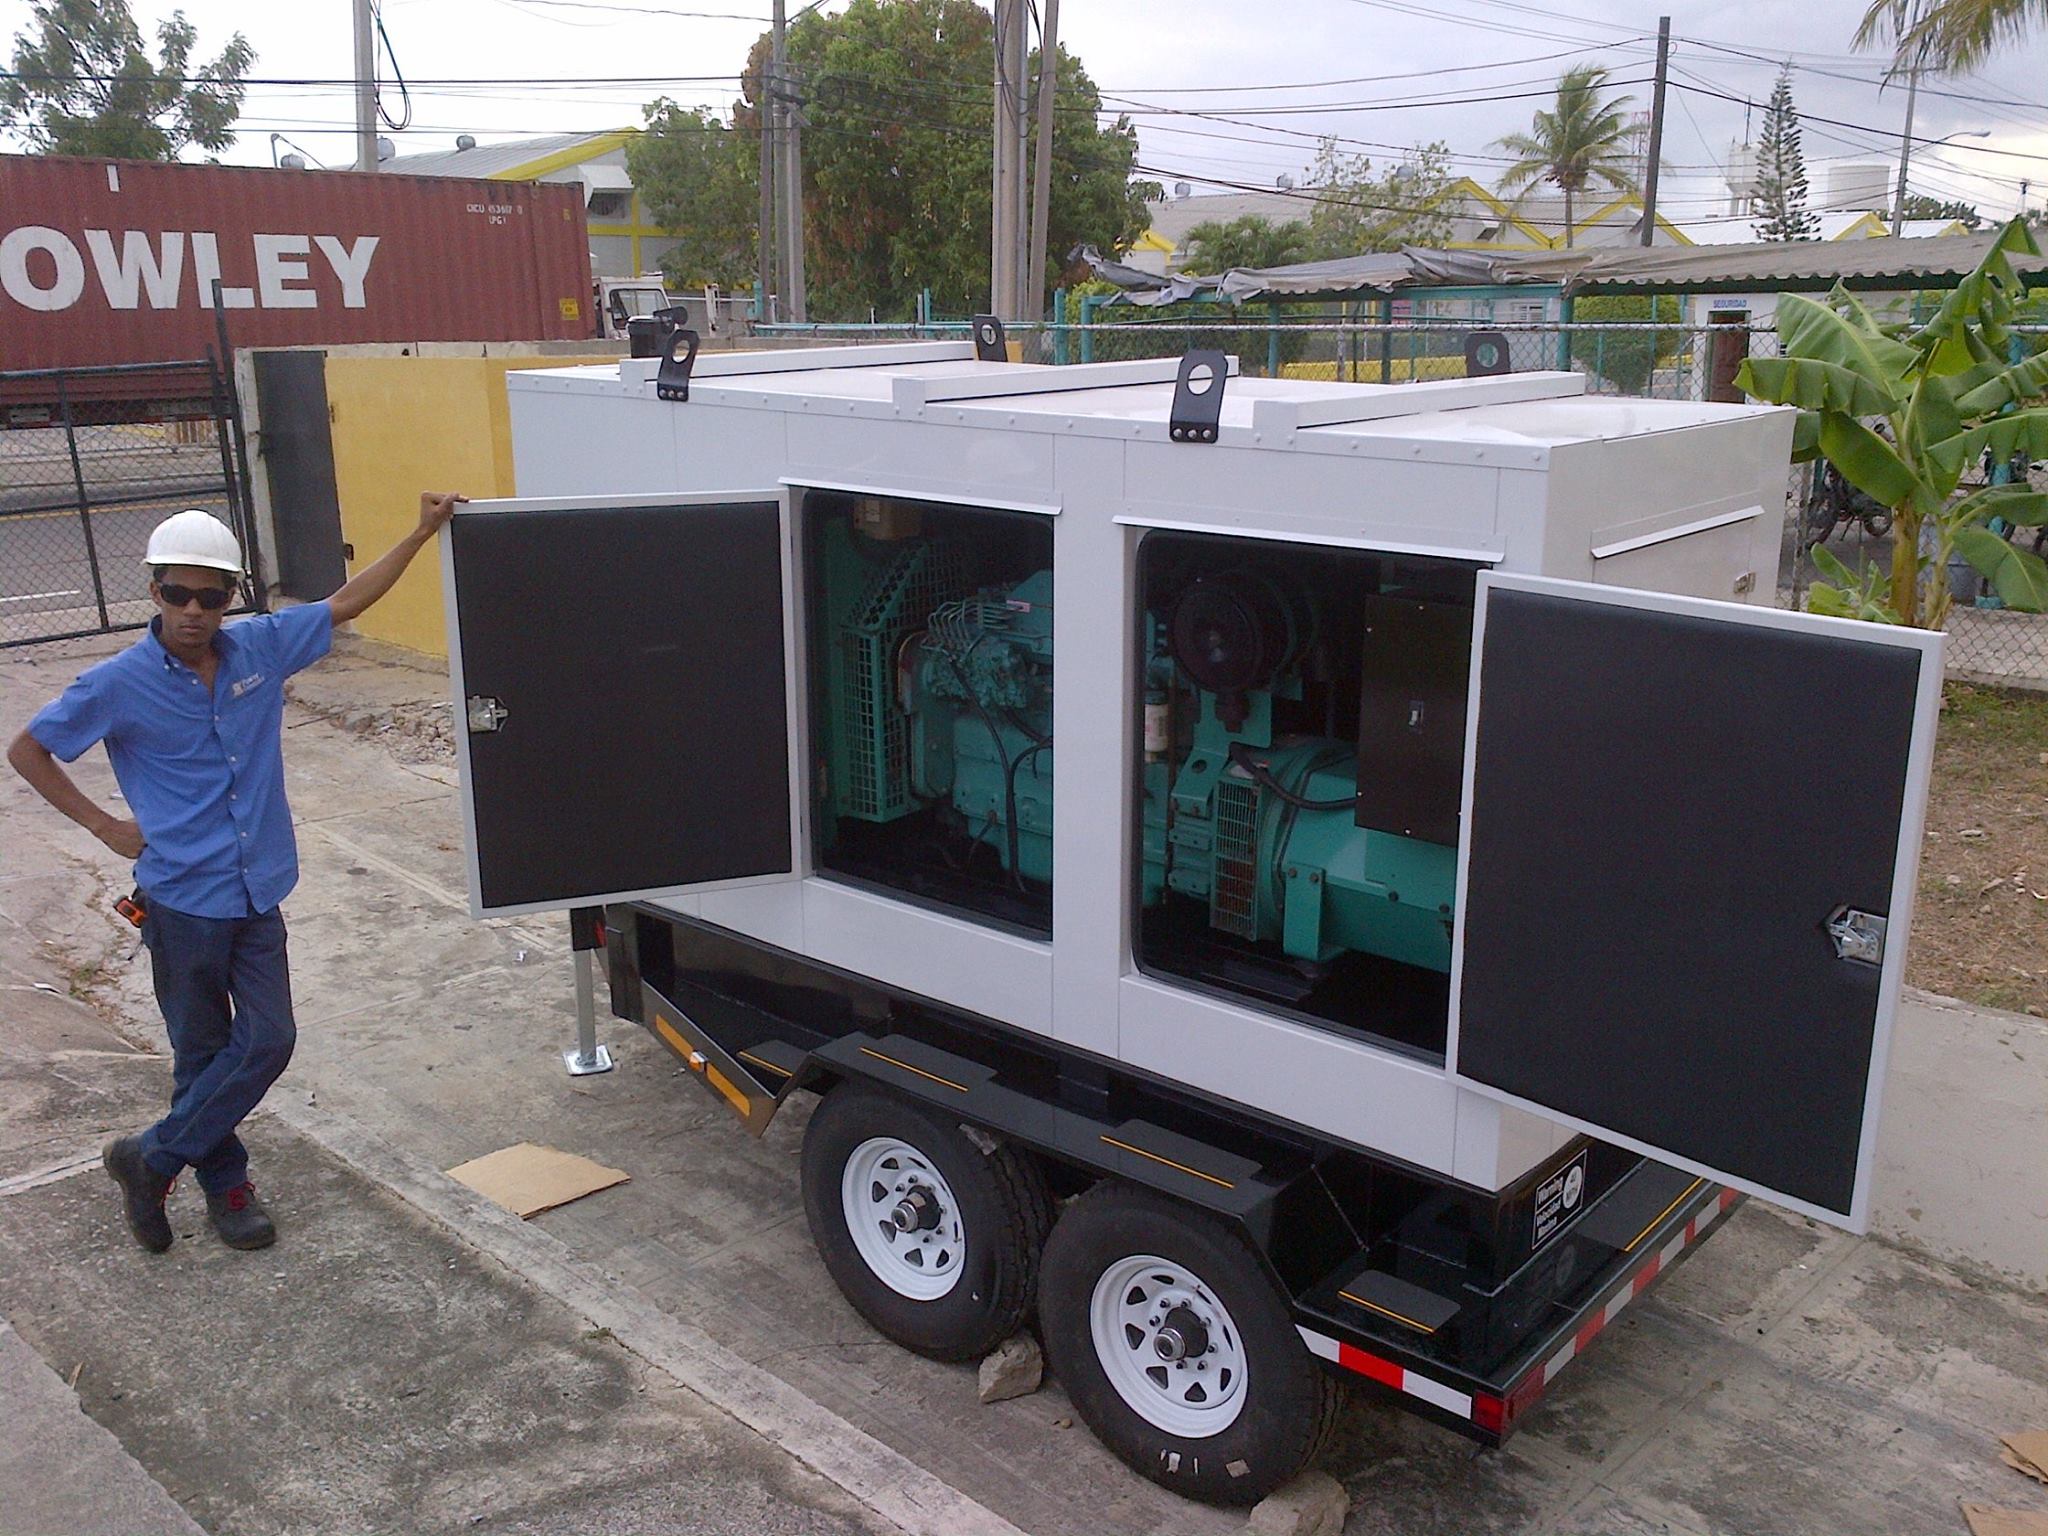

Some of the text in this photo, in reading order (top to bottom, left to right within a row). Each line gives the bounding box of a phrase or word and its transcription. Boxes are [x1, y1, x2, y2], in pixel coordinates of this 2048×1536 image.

[0, 225, 380, 311] OWLEY
[1713, 299, 1747, 308] SEGURIDAD
[1538, 1176, 1563, 1205] Warning
